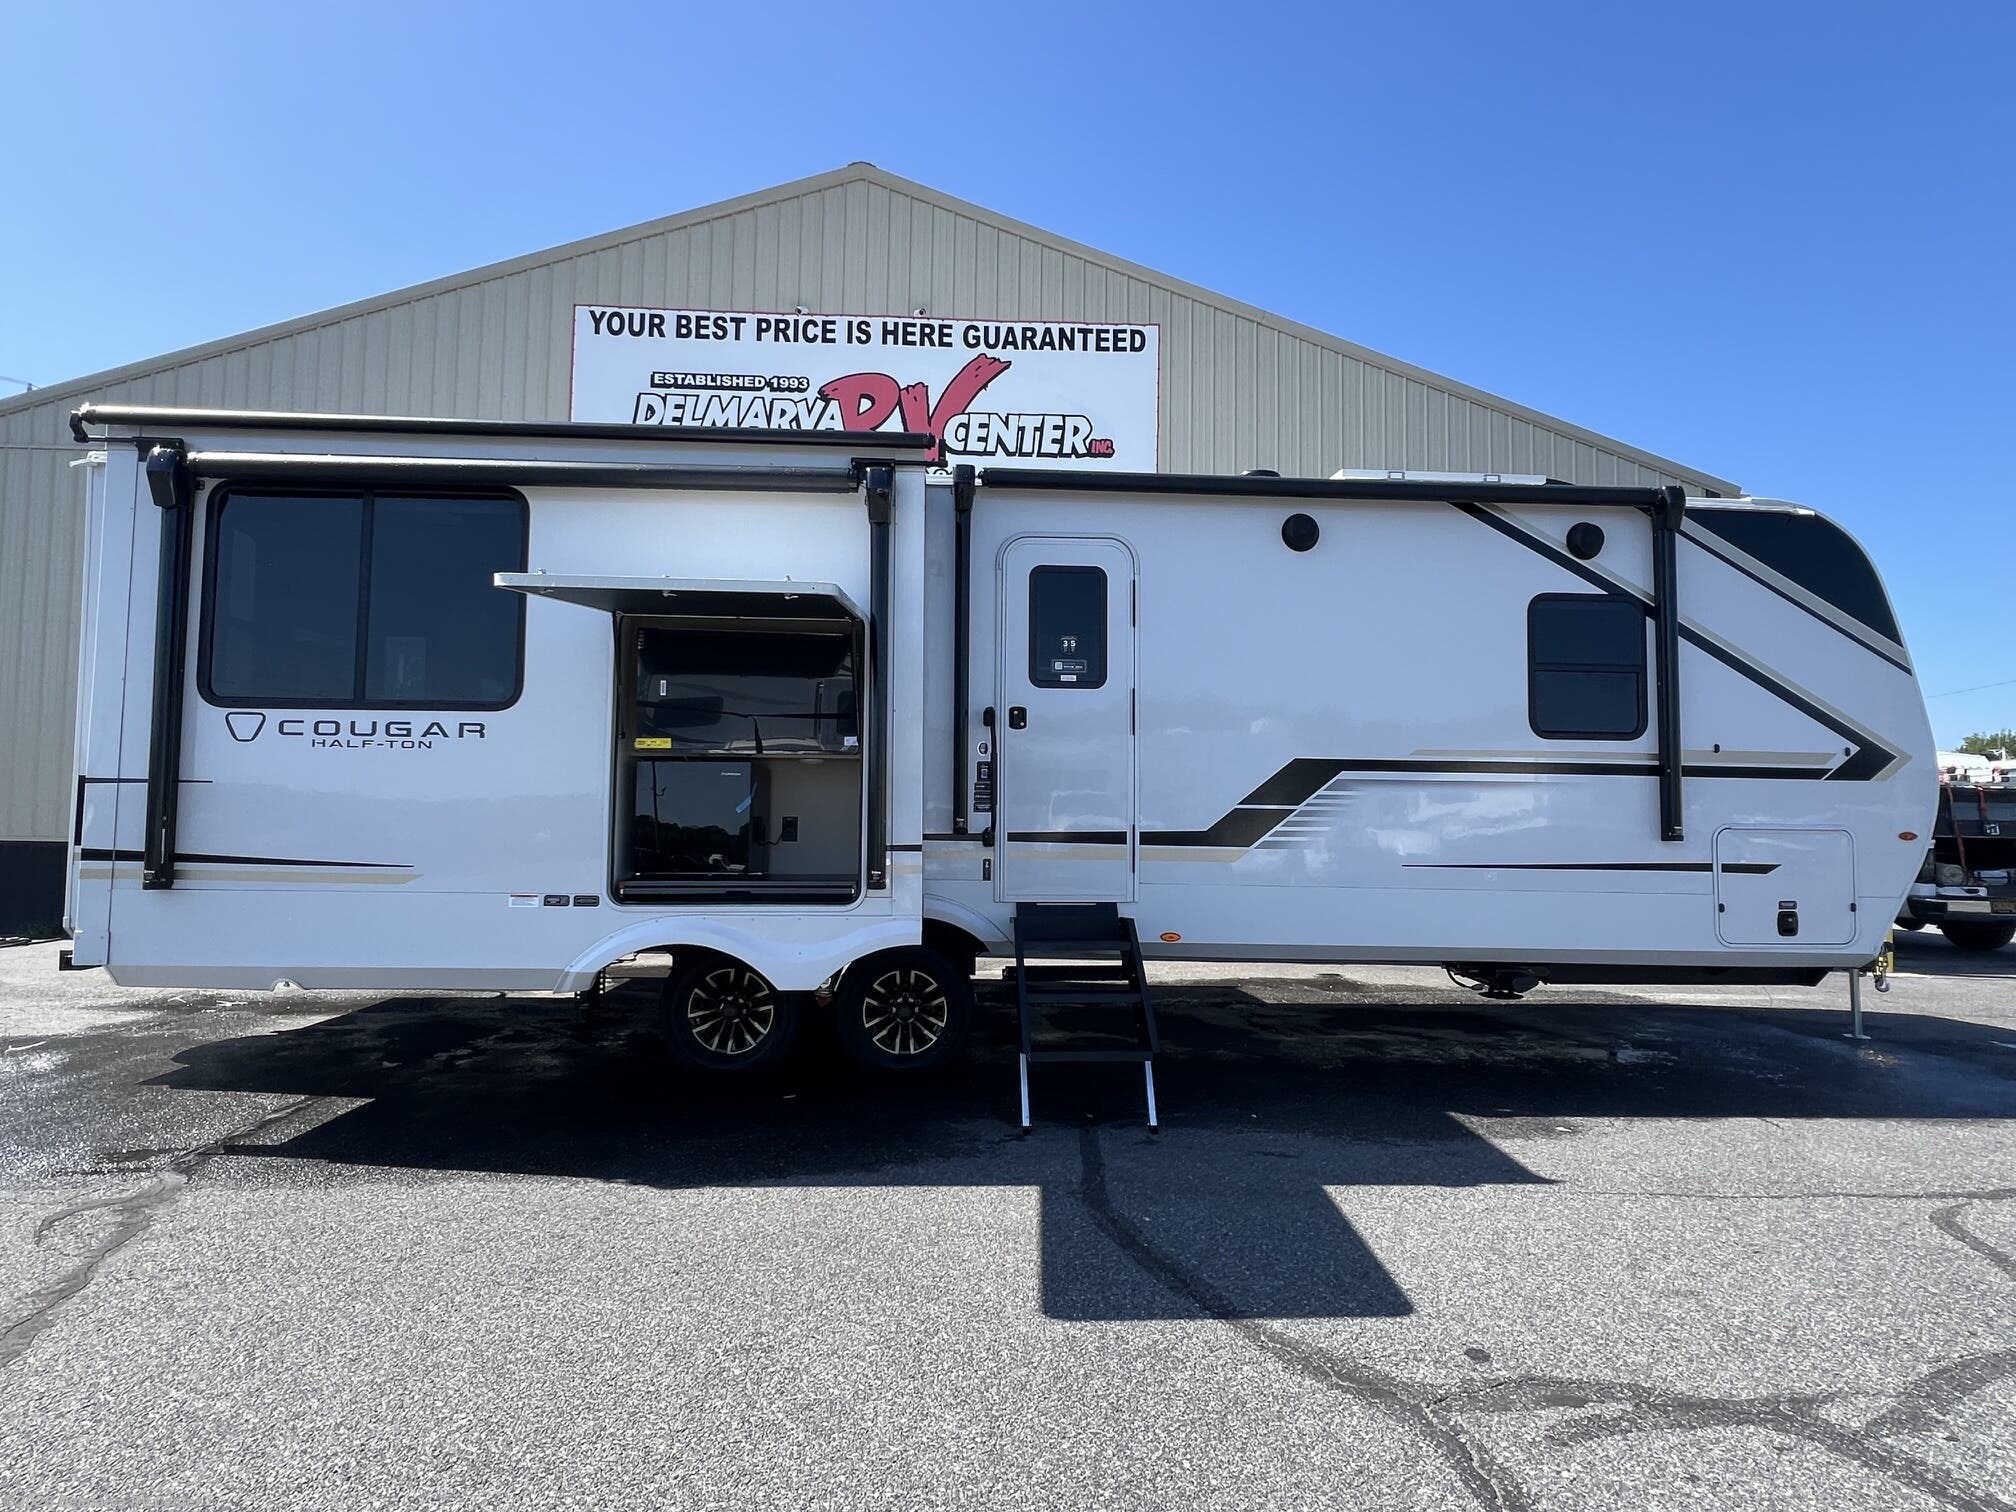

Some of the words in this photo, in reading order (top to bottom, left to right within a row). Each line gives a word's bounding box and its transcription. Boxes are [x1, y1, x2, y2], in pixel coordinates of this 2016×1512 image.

[589, 310, 666, 338] YOUR
[675, 314, 747, 341] BEST
[755, 317, 837, 344] PRICE
[847, 320, 872, 345] IS
[881, 321, 954, 347] HERE
[962, 324, 1147, 352] GUARANTEED
[653, 373, 766, 389] ESTABLISHED
[769, 376, 809, 389] 1993
[633, 392, 844, 432] DELMARVA
[817, 353, 1012, 461] RV
[942, 412, 1092, 457] CENTER
[278, 720, 486, 739] COUGAR
[311, 738, 432, 750] HALF-TON
